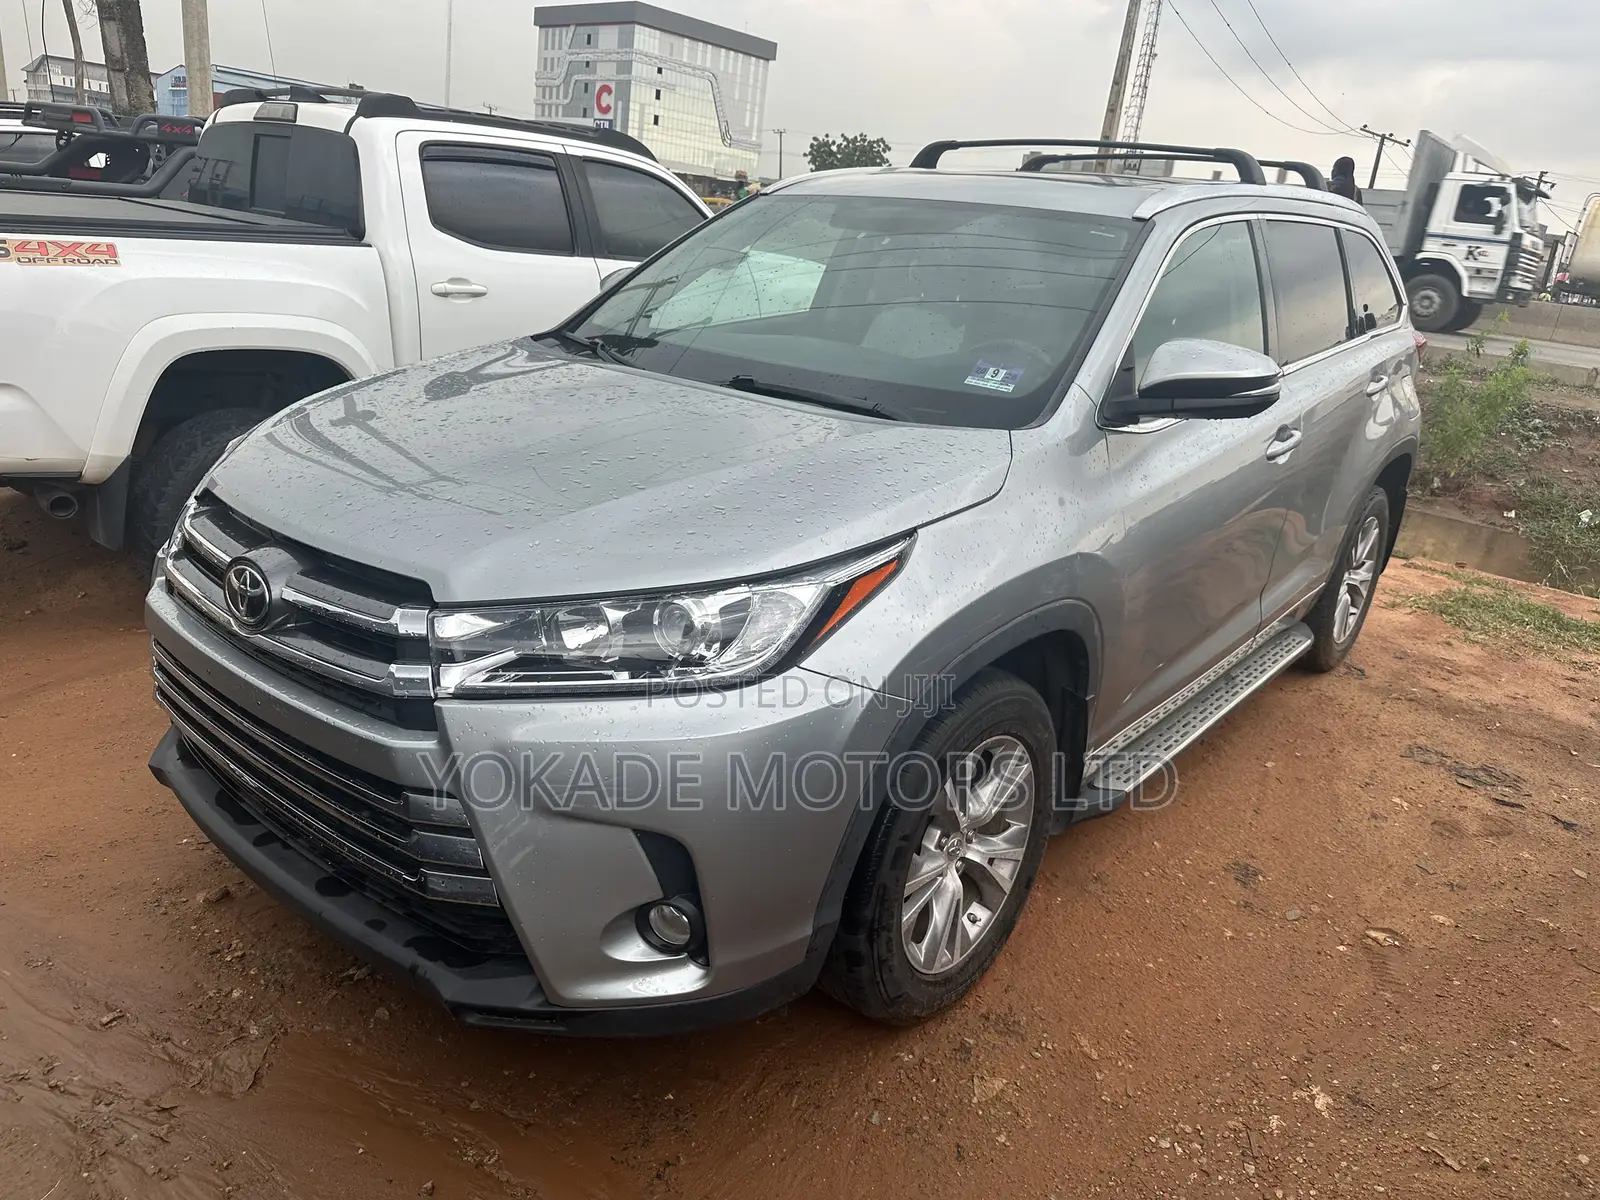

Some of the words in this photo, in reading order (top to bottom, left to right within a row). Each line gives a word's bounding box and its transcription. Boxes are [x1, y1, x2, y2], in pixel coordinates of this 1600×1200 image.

[596, 84, 613, 115] C
[17, 256, 59, 264] OFF
[62, 257, 119, 265] ROAD
[991, 368, 1000, 378] 9
